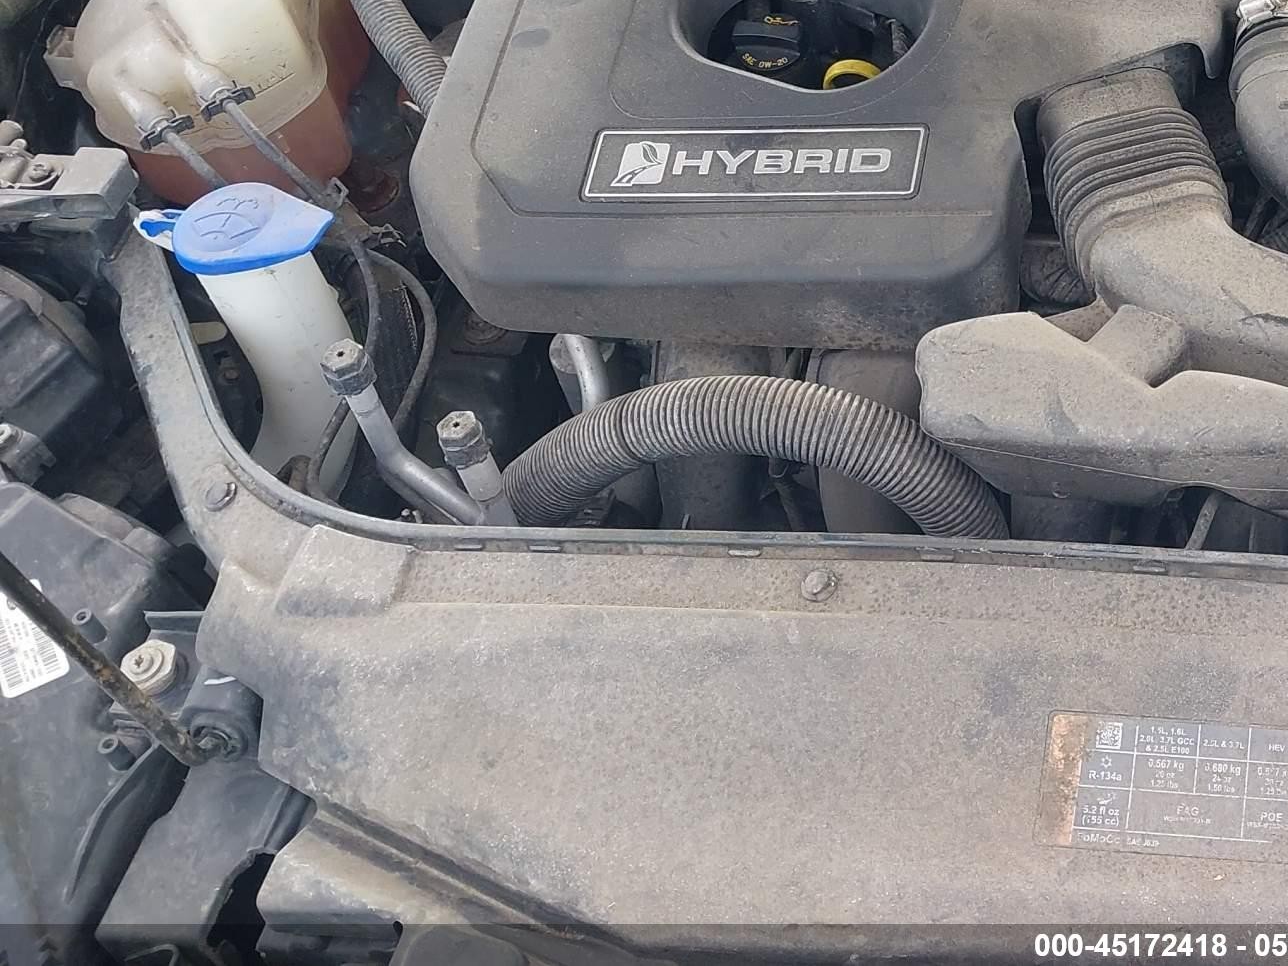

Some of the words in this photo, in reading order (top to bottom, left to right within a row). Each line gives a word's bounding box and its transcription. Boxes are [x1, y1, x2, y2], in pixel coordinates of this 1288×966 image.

[742, 53, 757, 65] SAE
[758, 57, 788, 68] 0W-20
[672, 148, 892, 175] HYBRID
[1177, 738, 1195, 746] GCC
[1268, 743, 1286, 752] HEV
[1148, 759, 1171, 769] 0.567
[1174, 760, 1185, 772] kg
[1230, 765, 1241, 776] kg
[1088, 770, 1122, 781] R-134a
[1082, 805, 1097, 814] 5.2
[1100, 806, 1106, 814] fl
[1108, 807, 1120, 816] oz
[1082, 815, 1102, 826] (155
[1105, 816, 1120, 826] cc)
[1260, 812, 1284, 822] POE
